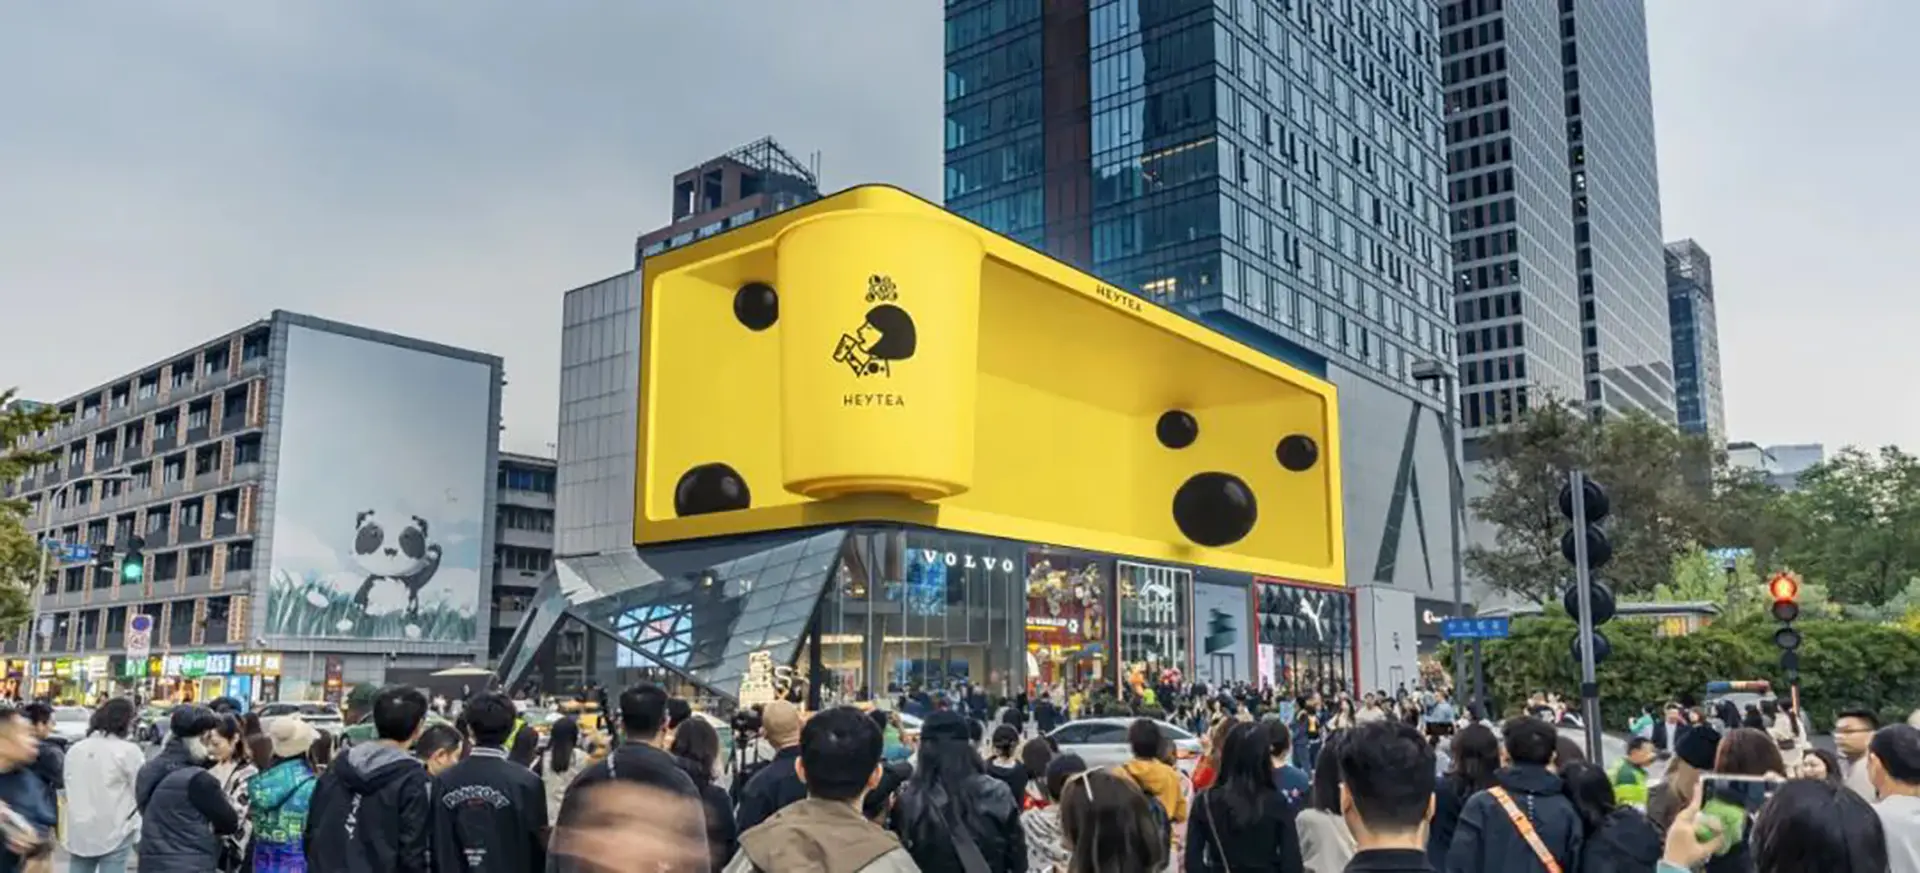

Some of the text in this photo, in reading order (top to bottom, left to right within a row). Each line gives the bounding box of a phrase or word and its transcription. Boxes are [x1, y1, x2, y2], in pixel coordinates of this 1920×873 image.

[1096, 285, 1142, 312] HEYTEA
[843, 393, 905, 407] HEYTEA
[923, 549, 1014, 573] VOLVO
